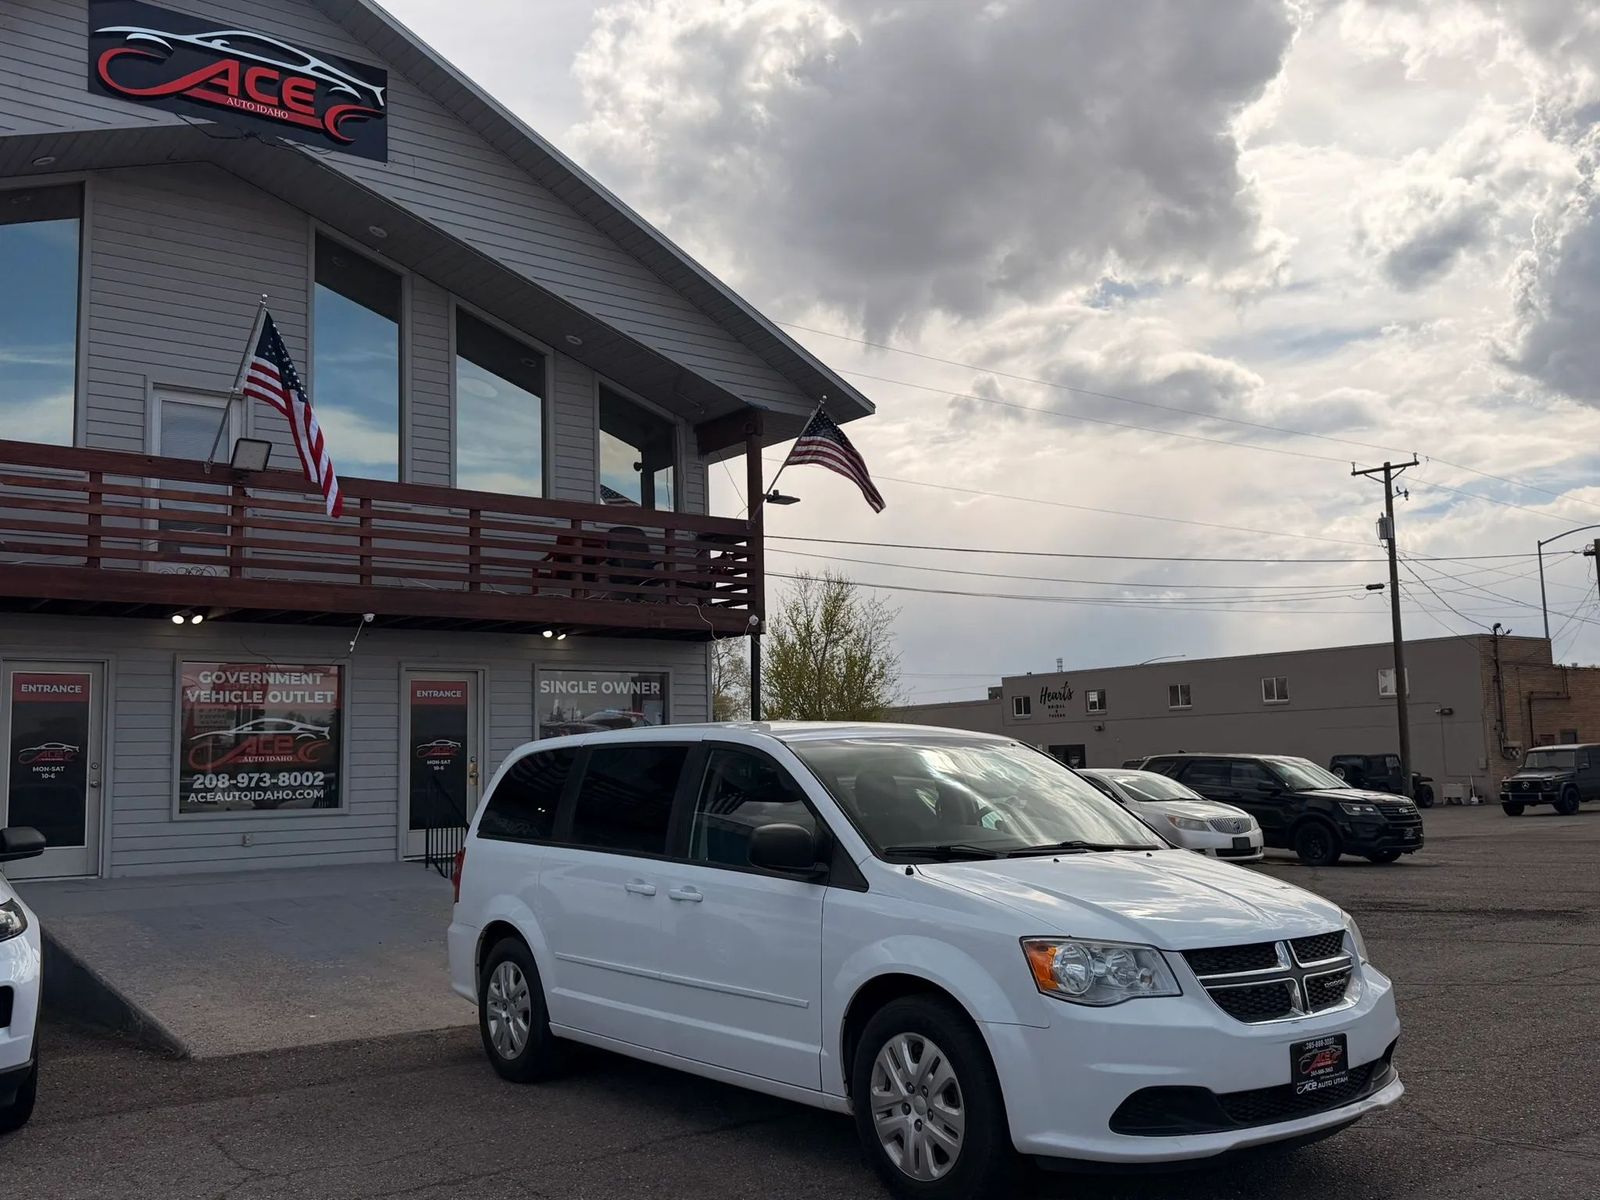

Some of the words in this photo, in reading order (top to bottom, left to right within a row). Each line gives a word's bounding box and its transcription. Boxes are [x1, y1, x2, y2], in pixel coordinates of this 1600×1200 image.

[165, 58, 316, 115] ACE
[226, 97, 255, 111] AUTO
[257, 104, 288, 120] IDAHO
[198, 671, 323, 685] GOVERNMENT
[21, 683, 82, 693] ENTRANCE
[416, 690, 462, 698] ENTRANCE
[540, 680, 597, 694] SINGLE
[601, 681, 660, 695] OWNER
[1040, 681, 1074, 705] Hearts
[186, 690, 263, 703] VEHICLE
[268, 690, 335, 704] OUTLET
[192, 771, 324, 789] 208-973-8002
[187, 789, 324, 803] ACEAUTOIDAHO.COM
